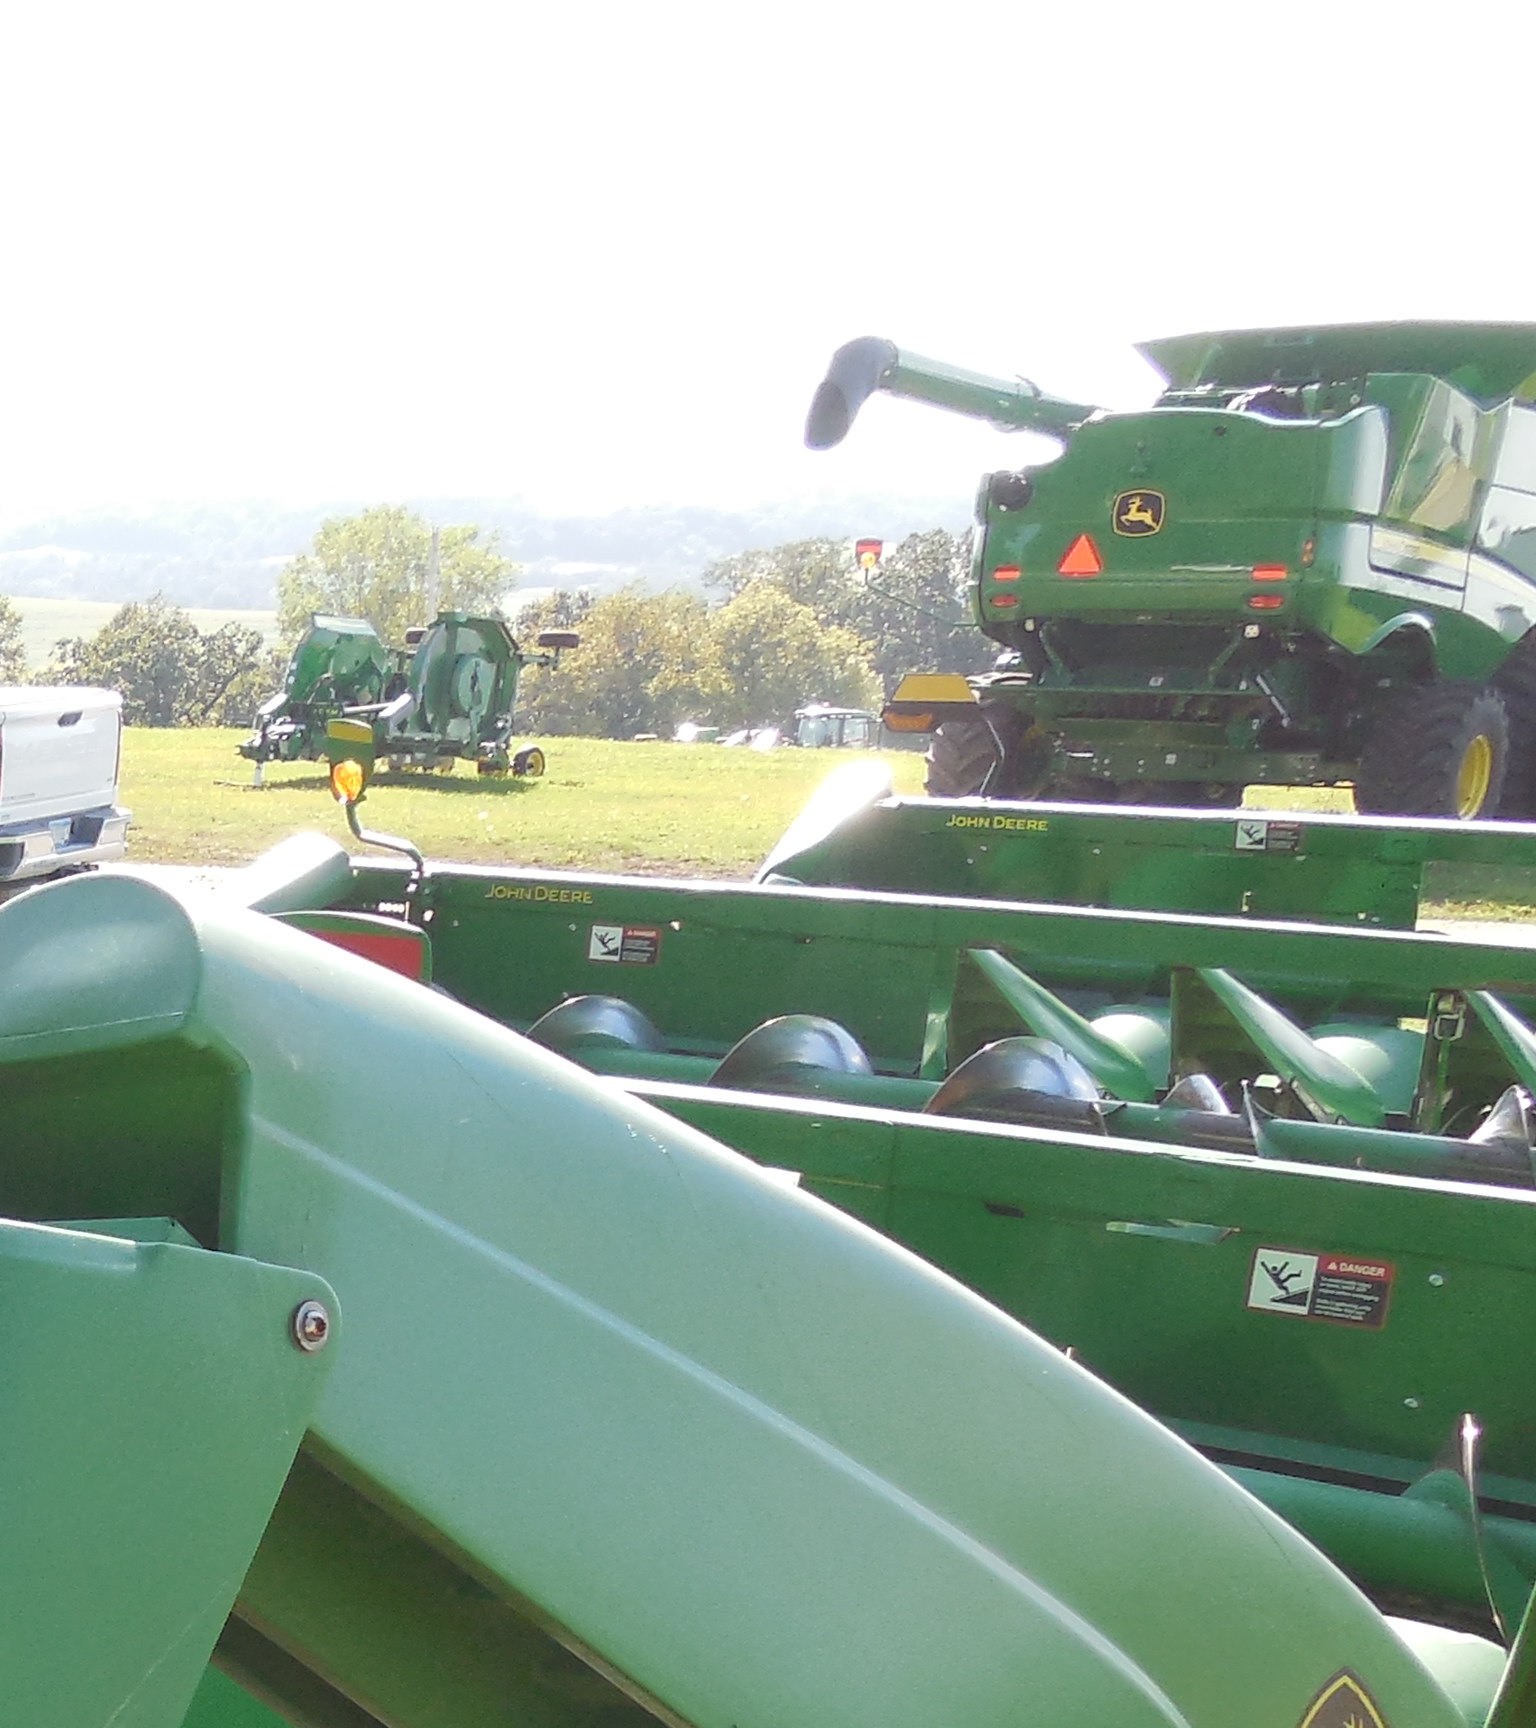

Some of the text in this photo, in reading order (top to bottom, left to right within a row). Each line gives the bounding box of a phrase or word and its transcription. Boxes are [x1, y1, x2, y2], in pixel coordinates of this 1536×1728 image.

[945, 814, 1049, 831] JOHN DEERE
[484, 883, 593, 904] JOHN DEERE
[1339, 1262, 1385, 1277] DANGER
